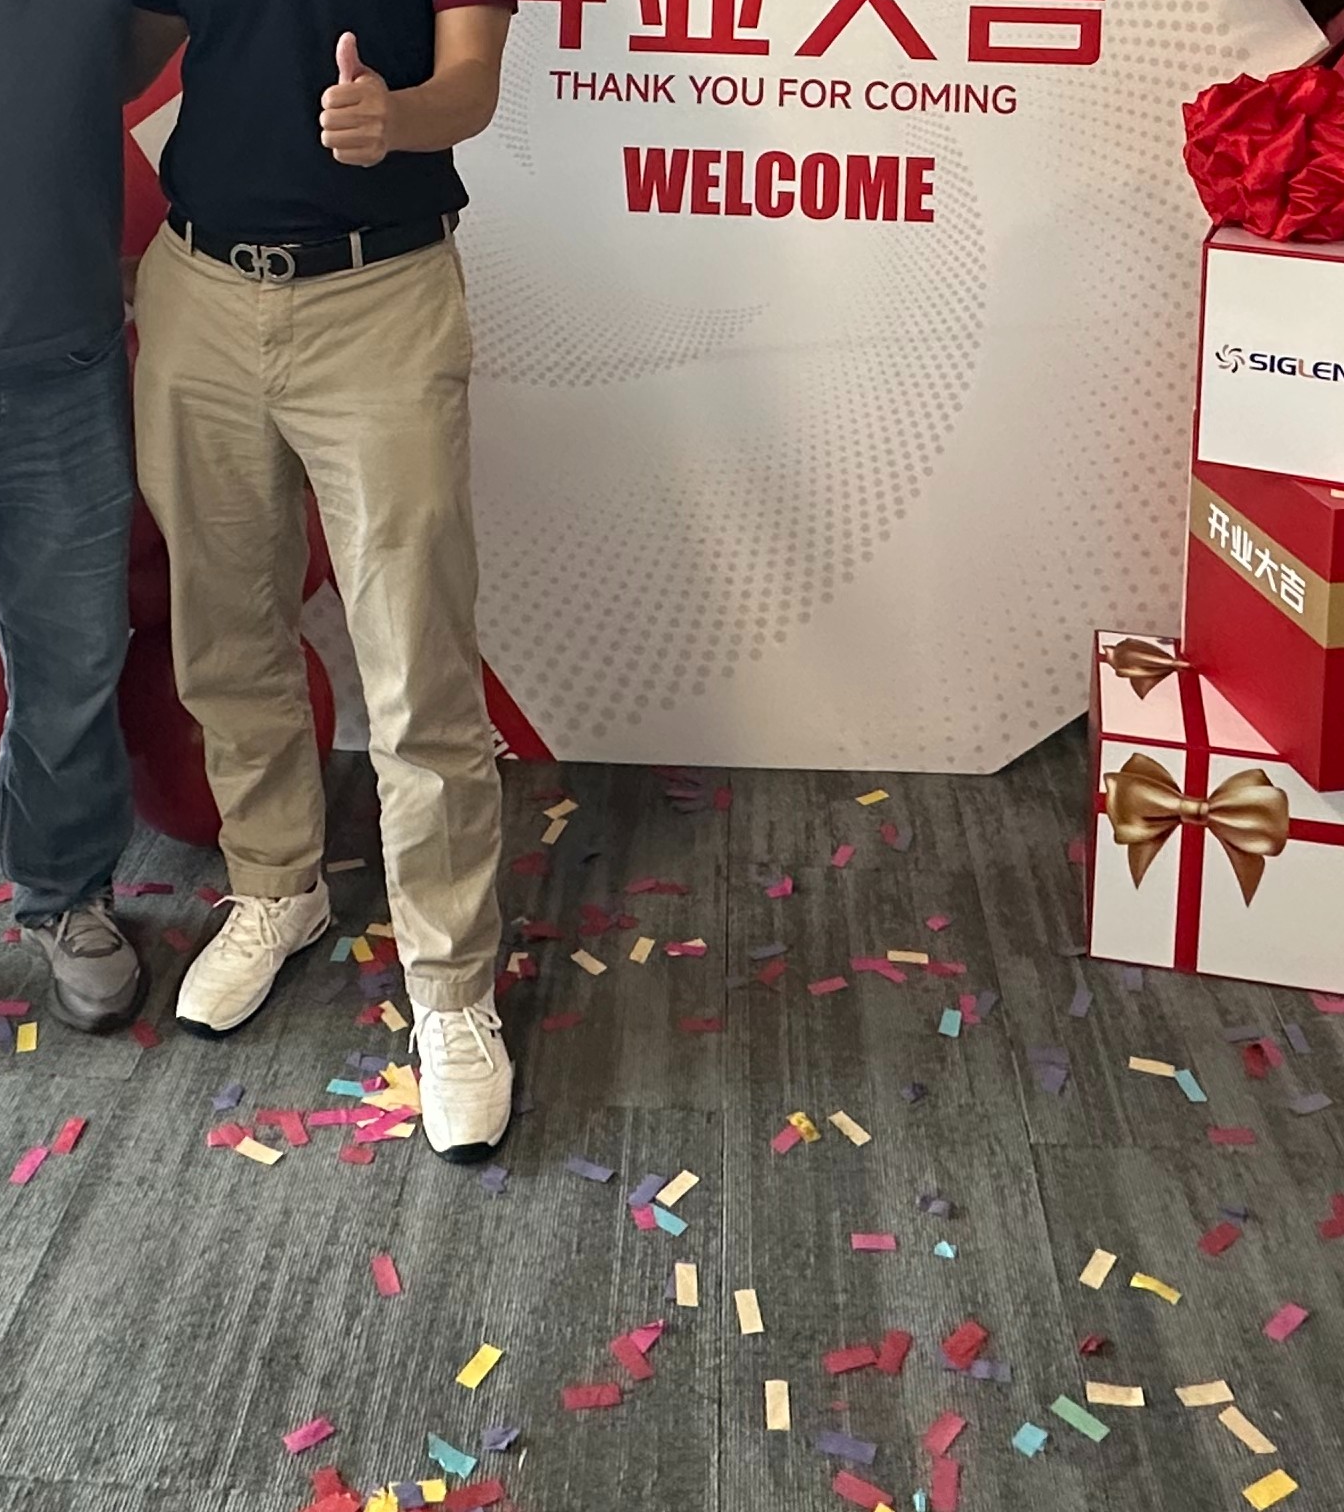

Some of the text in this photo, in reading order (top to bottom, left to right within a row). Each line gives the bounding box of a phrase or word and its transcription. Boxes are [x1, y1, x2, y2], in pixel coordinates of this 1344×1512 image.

[549, 70, 1019, 115] THANK YOU FOR COMING
[622, 146, 936, 223] WELCOME
[1207, 502, 1306, 614] 开业大吉
